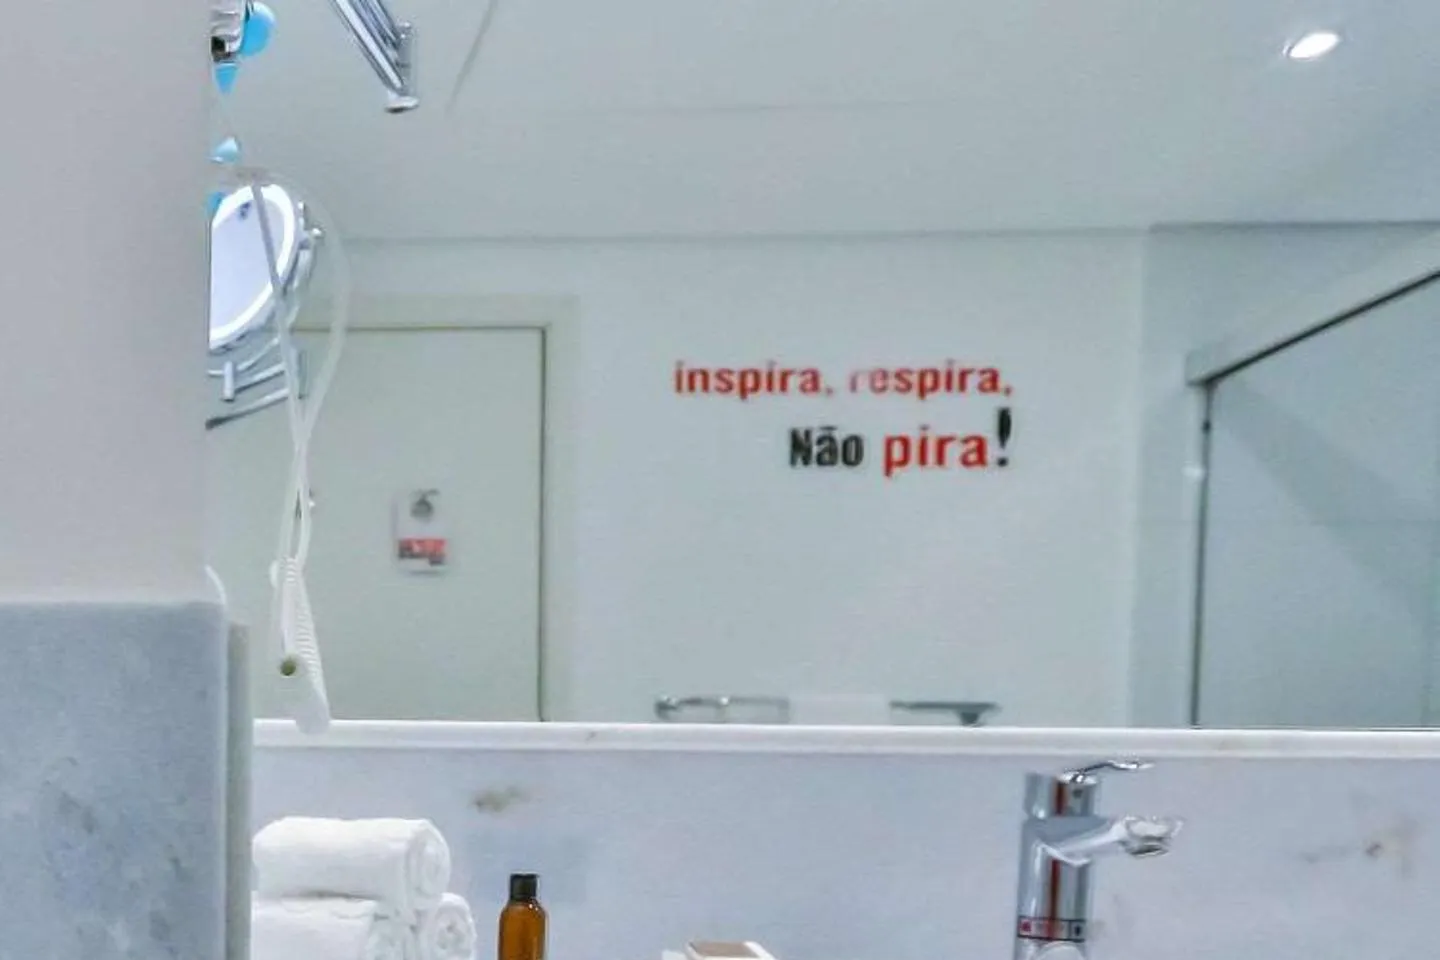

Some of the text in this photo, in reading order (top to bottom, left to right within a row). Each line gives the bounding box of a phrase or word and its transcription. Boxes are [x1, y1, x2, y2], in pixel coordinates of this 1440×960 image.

[673, 360, 1013, 400] inspira, respira,
[788, 407, 1013, 477] Não pira!
